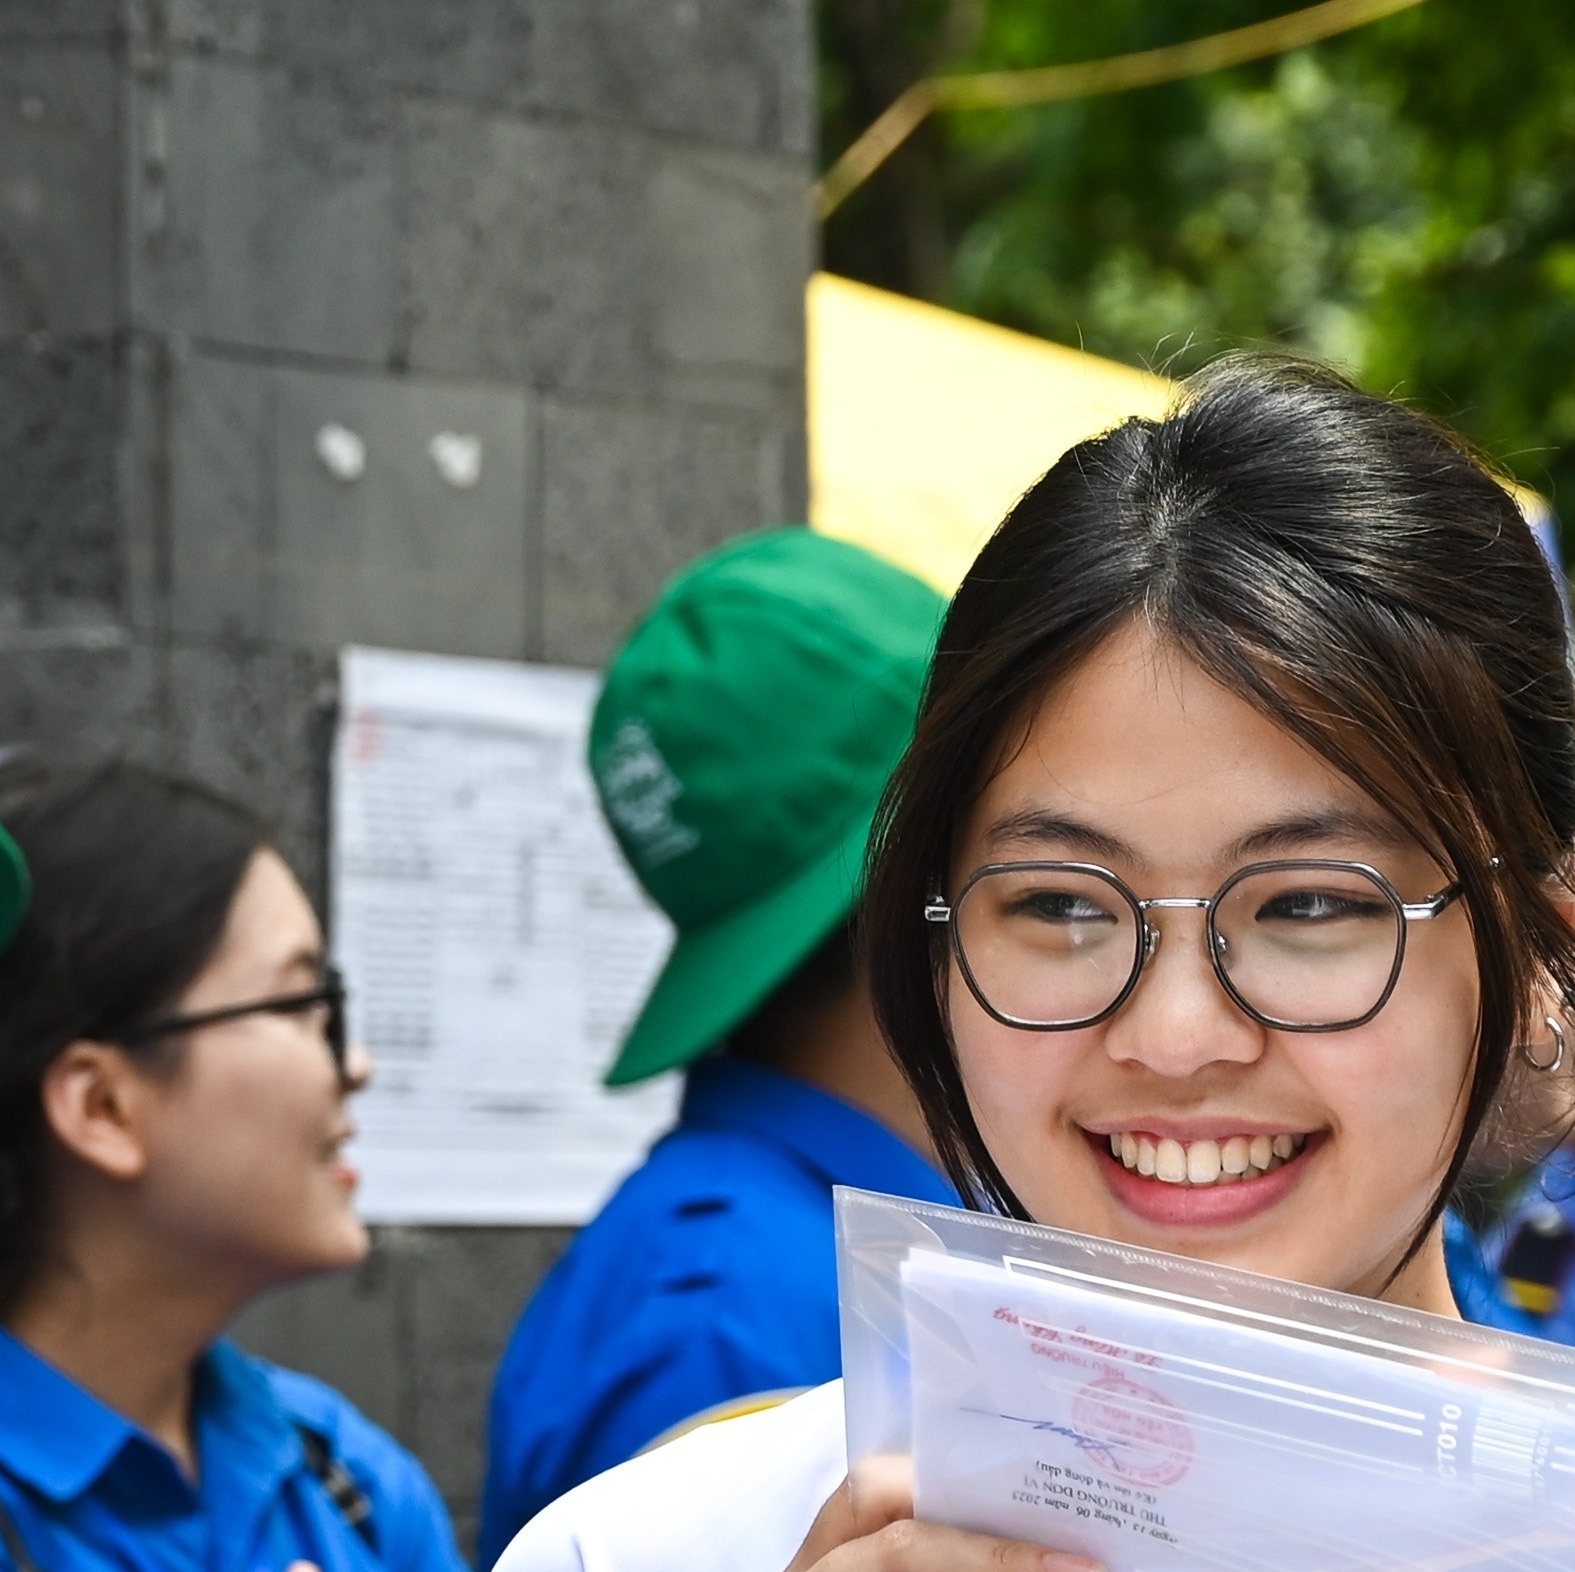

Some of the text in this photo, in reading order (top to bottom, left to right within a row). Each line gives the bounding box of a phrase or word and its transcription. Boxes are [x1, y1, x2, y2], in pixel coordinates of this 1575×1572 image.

[1062, 1467, 1094, 1486] đóng
[1010, 1488, 1090, 1518] 06 năm 2025
